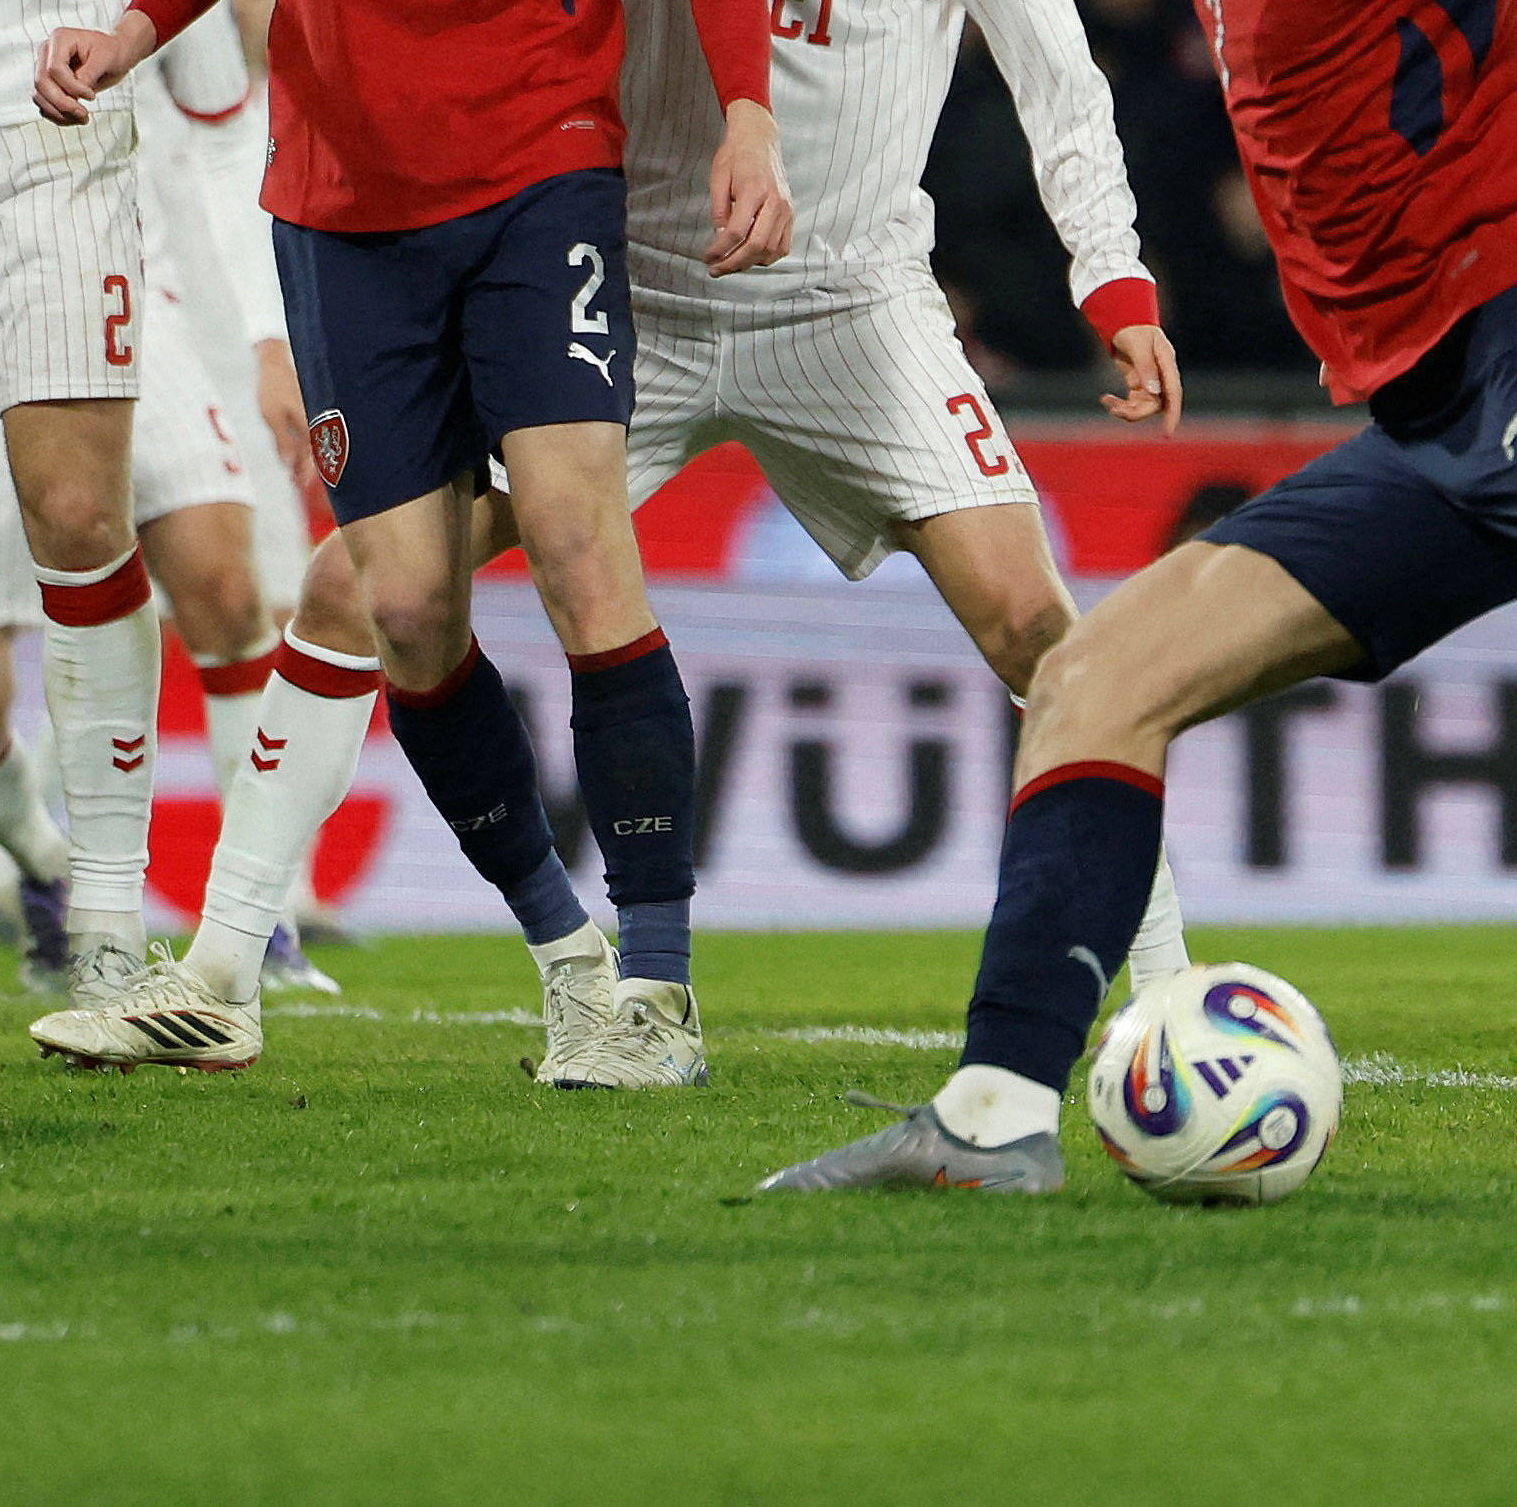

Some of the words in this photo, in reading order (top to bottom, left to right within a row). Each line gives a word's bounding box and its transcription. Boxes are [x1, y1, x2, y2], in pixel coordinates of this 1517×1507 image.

[568, 242, 609, 335] 2
[103, 274, 133, 367] 2
[449, 802, 509, 833] CZE
[613, 815, 674, 836] CZE
